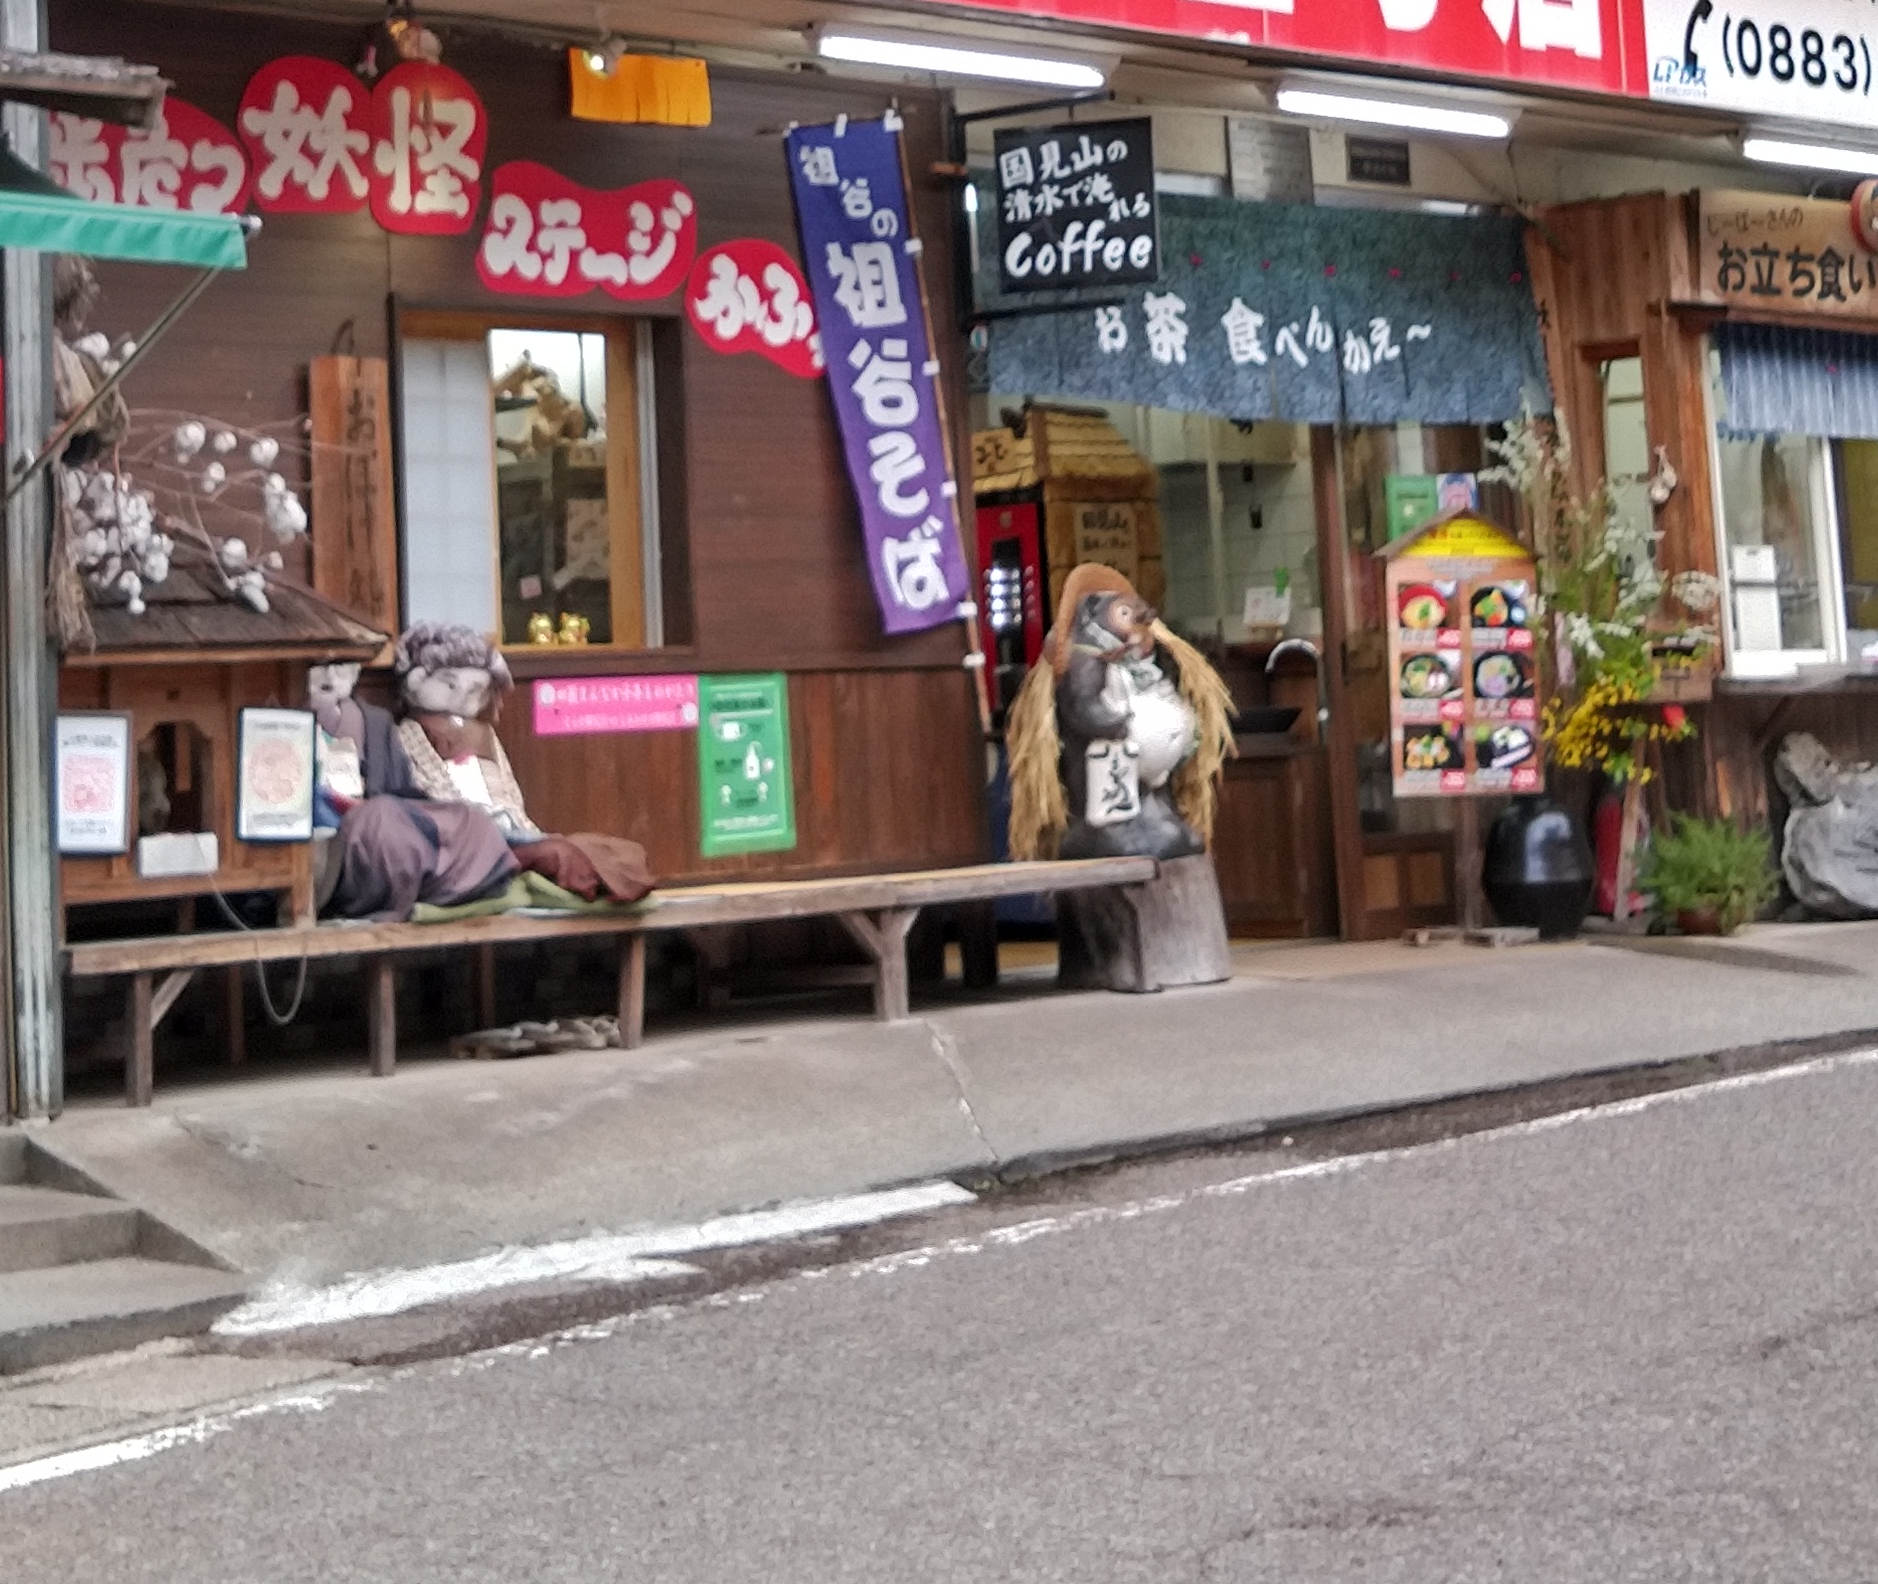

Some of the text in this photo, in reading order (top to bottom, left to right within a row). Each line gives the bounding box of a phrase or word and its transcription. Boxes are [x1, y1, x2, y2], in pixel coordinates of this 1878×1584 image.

[242, 79, 481, 216] 妖怪
[799, 144, 899, 238] 祖谷の
[999, 135, 1128, 190] 国見山の
[482, 189, 694, 284] ステージ
[1005, 219, 1154, 279] Coffee
[694, 252, 824, 369] かふ
[825, 240, 951, 610] 祖谷そば
